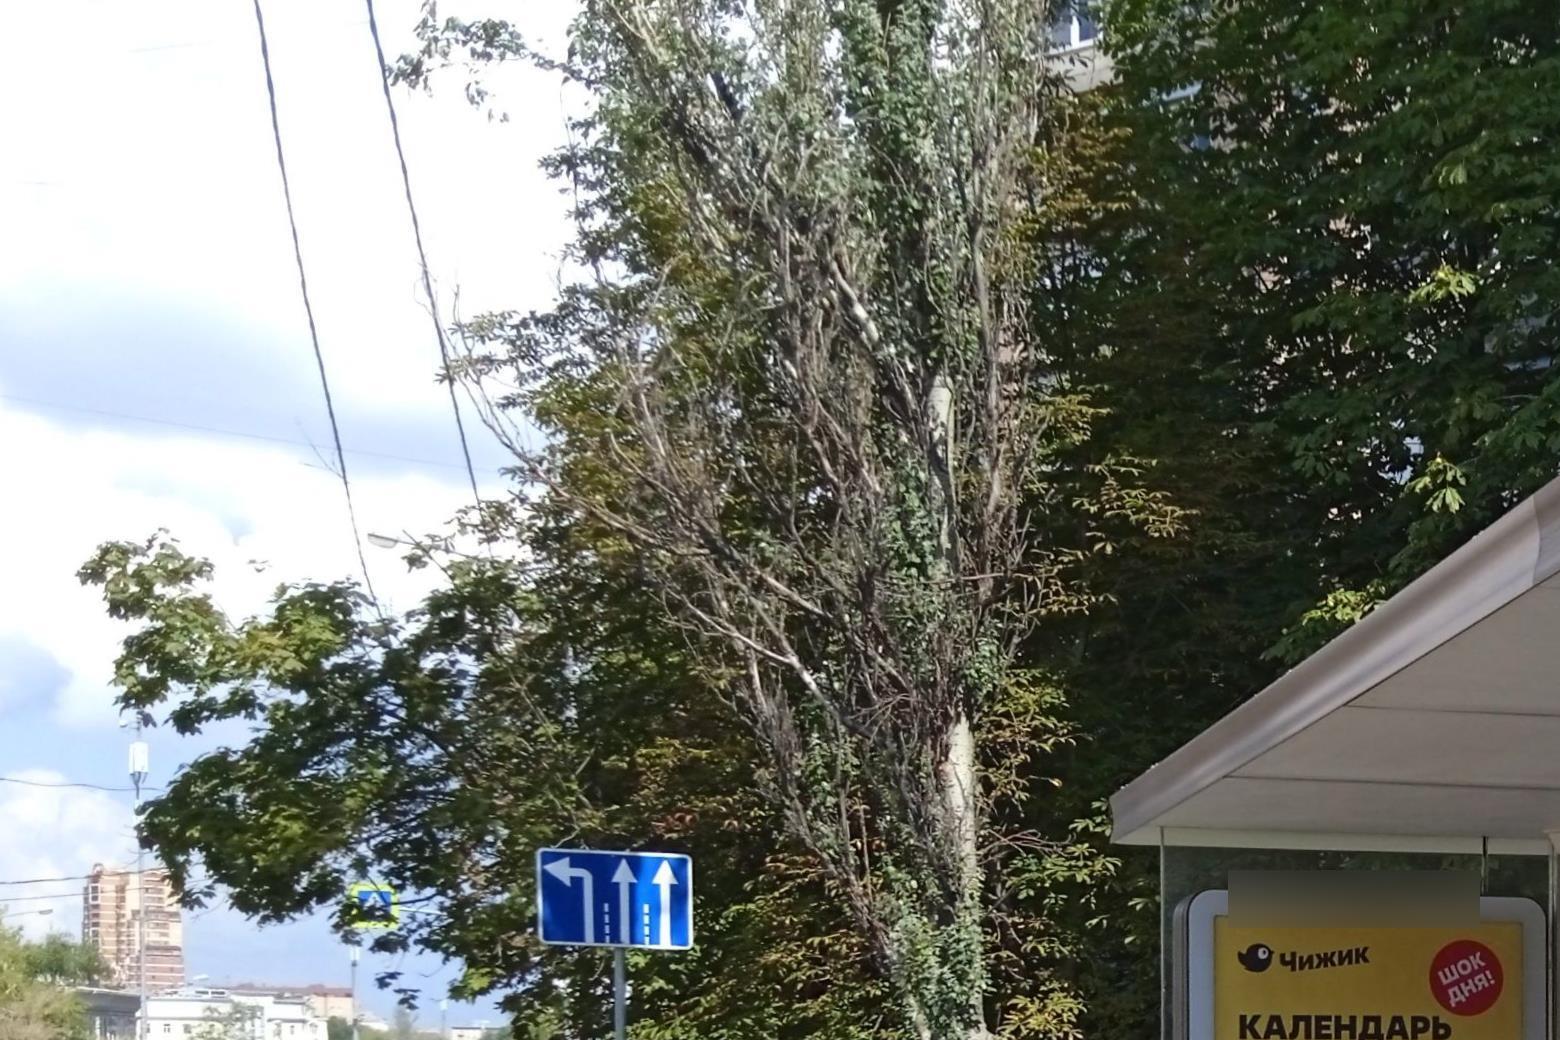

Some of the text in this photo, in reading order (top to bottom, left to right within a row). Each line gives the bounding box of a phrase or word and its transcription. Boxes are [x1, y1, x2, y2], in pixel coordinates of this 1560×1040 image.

[1280, 947, 1370, 972] Чижик
[1438, 951, 1486, 986] ШОК
[1448, 971, 1495, 1008] ДНЯ!
